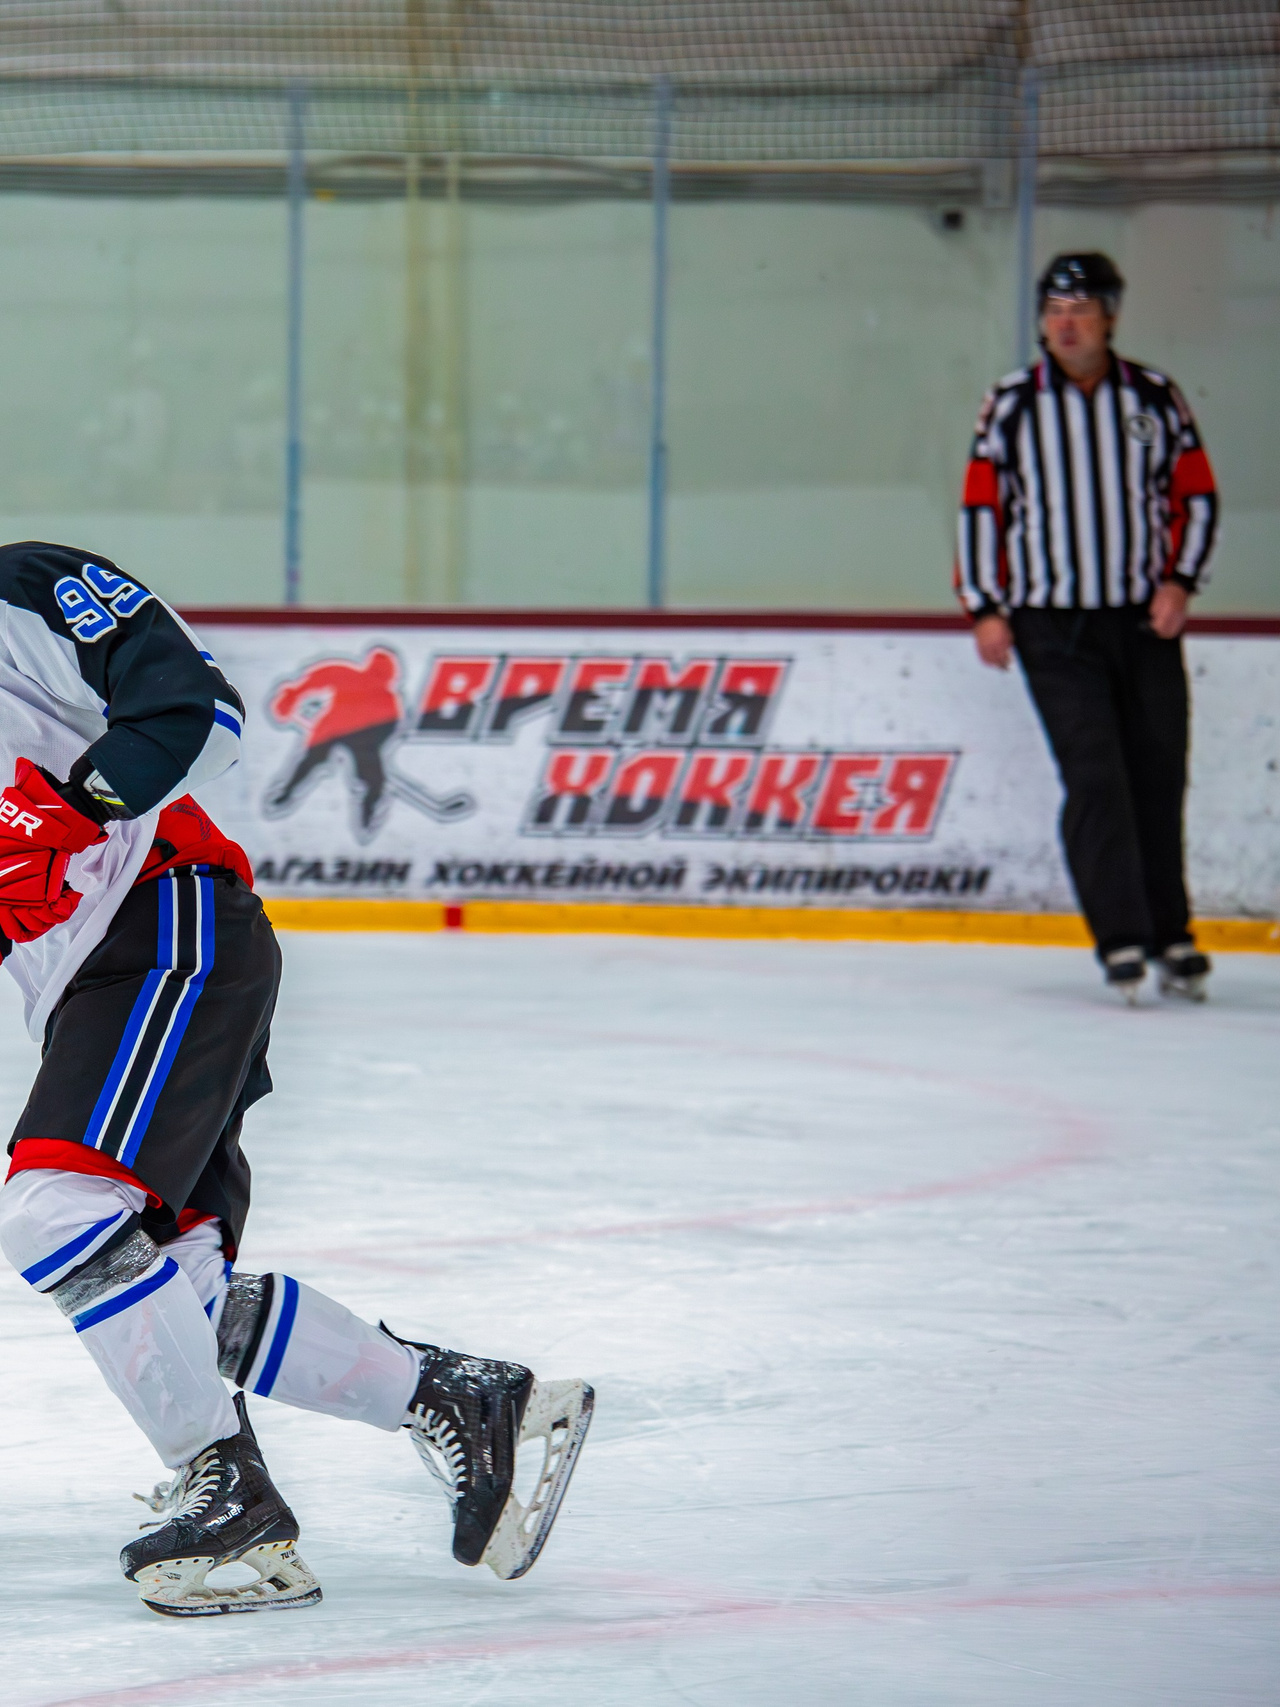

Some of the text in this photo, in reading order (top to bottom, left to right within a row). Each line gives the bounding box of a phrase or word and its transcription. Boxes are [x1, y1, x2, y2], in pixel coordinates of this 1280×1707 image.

[410, 657, 788, 737] ВРЕМЯ
[530, 752, 954, 836] ХОККЕЯ
[255, 857, 992, 896] АГАЗИН ХОККЕЙНОЙ ЭКИПИРОВКИ
